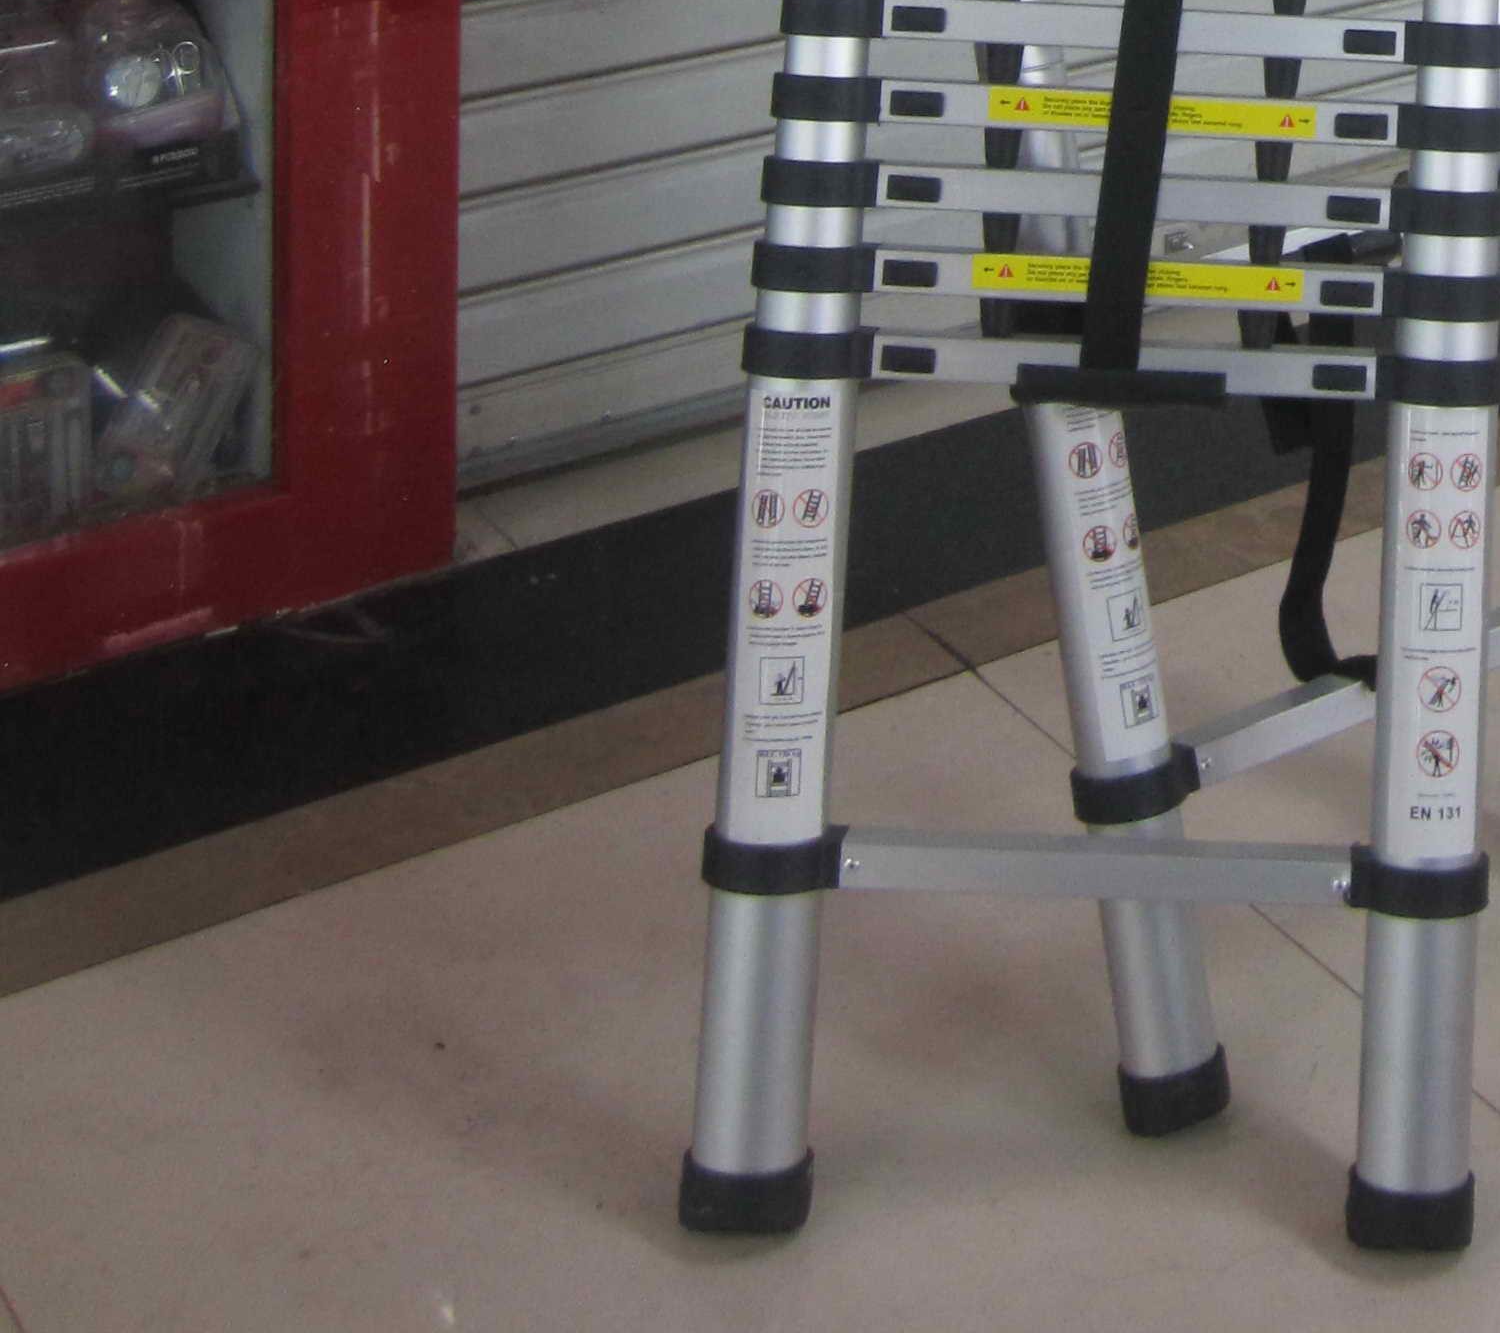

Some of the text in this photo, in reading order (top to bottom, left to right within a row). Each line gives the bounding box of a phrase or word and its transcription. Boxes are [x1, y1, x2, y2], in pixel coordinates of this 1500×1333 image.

[763, 395, 831, 410] CAUTION
[1409, 805, 1462, 821] EN 131
